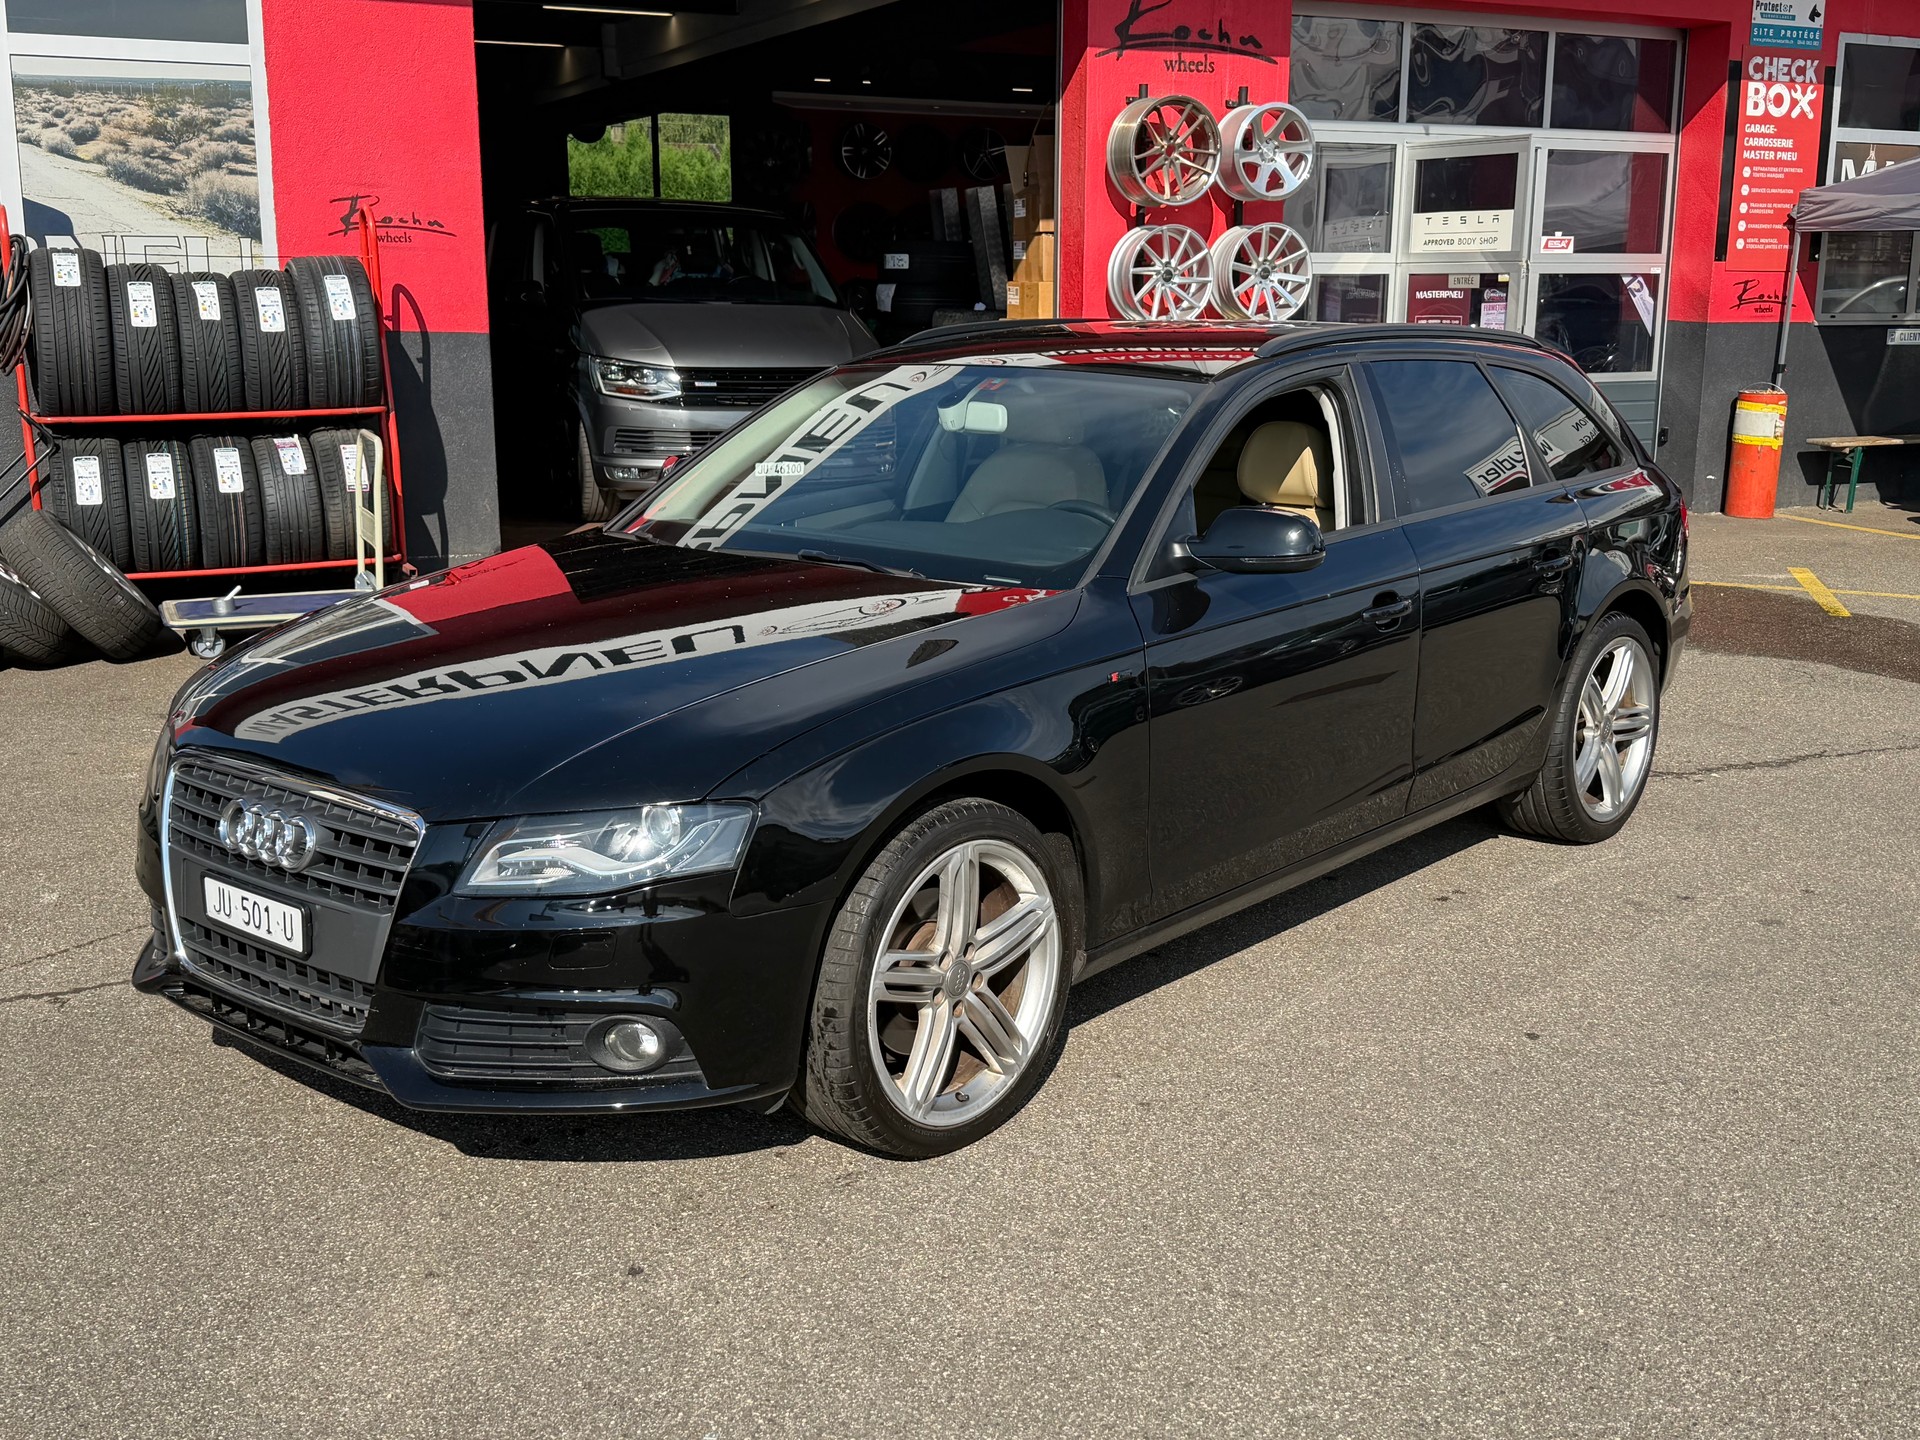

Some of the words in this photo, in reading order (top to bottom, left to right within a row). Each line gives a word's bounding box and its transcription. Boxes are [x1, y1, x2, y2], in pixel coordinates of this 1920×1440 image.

[1753, 27, 1774, 36] SITE
[1780, 29, 1820, 39] PROTÉGÉ
[1163, 53, 1215, 73] wheels
[1748, 55, 1820, 84] CHECK
[1746, 81, 1818, 119] BOX
[1744, 137, 1794, 148] CARROSSERIE
[1743, 150, 1775, 160] MASTER
[1776, 151, 1798, 161] PNEU
[1425, 214, 1500, 226] TESLA
[377, 231, 412, 243] wheels
[1423, 238, 1455, 246] APPROVED
[1457, 237, 1477, 246] BODY
[1479, 236, 1498, 245] SHOP
[1453, 276, 1474, 285] ENTRÉE
[1415, 290, 1464, 299] MASTERPNEU
[1754, 304, 1773, 313] wheels
[213, 886, 232, 917] JU
[241, 895, 273, 935] 501
[283, 911, 294, 942] U
